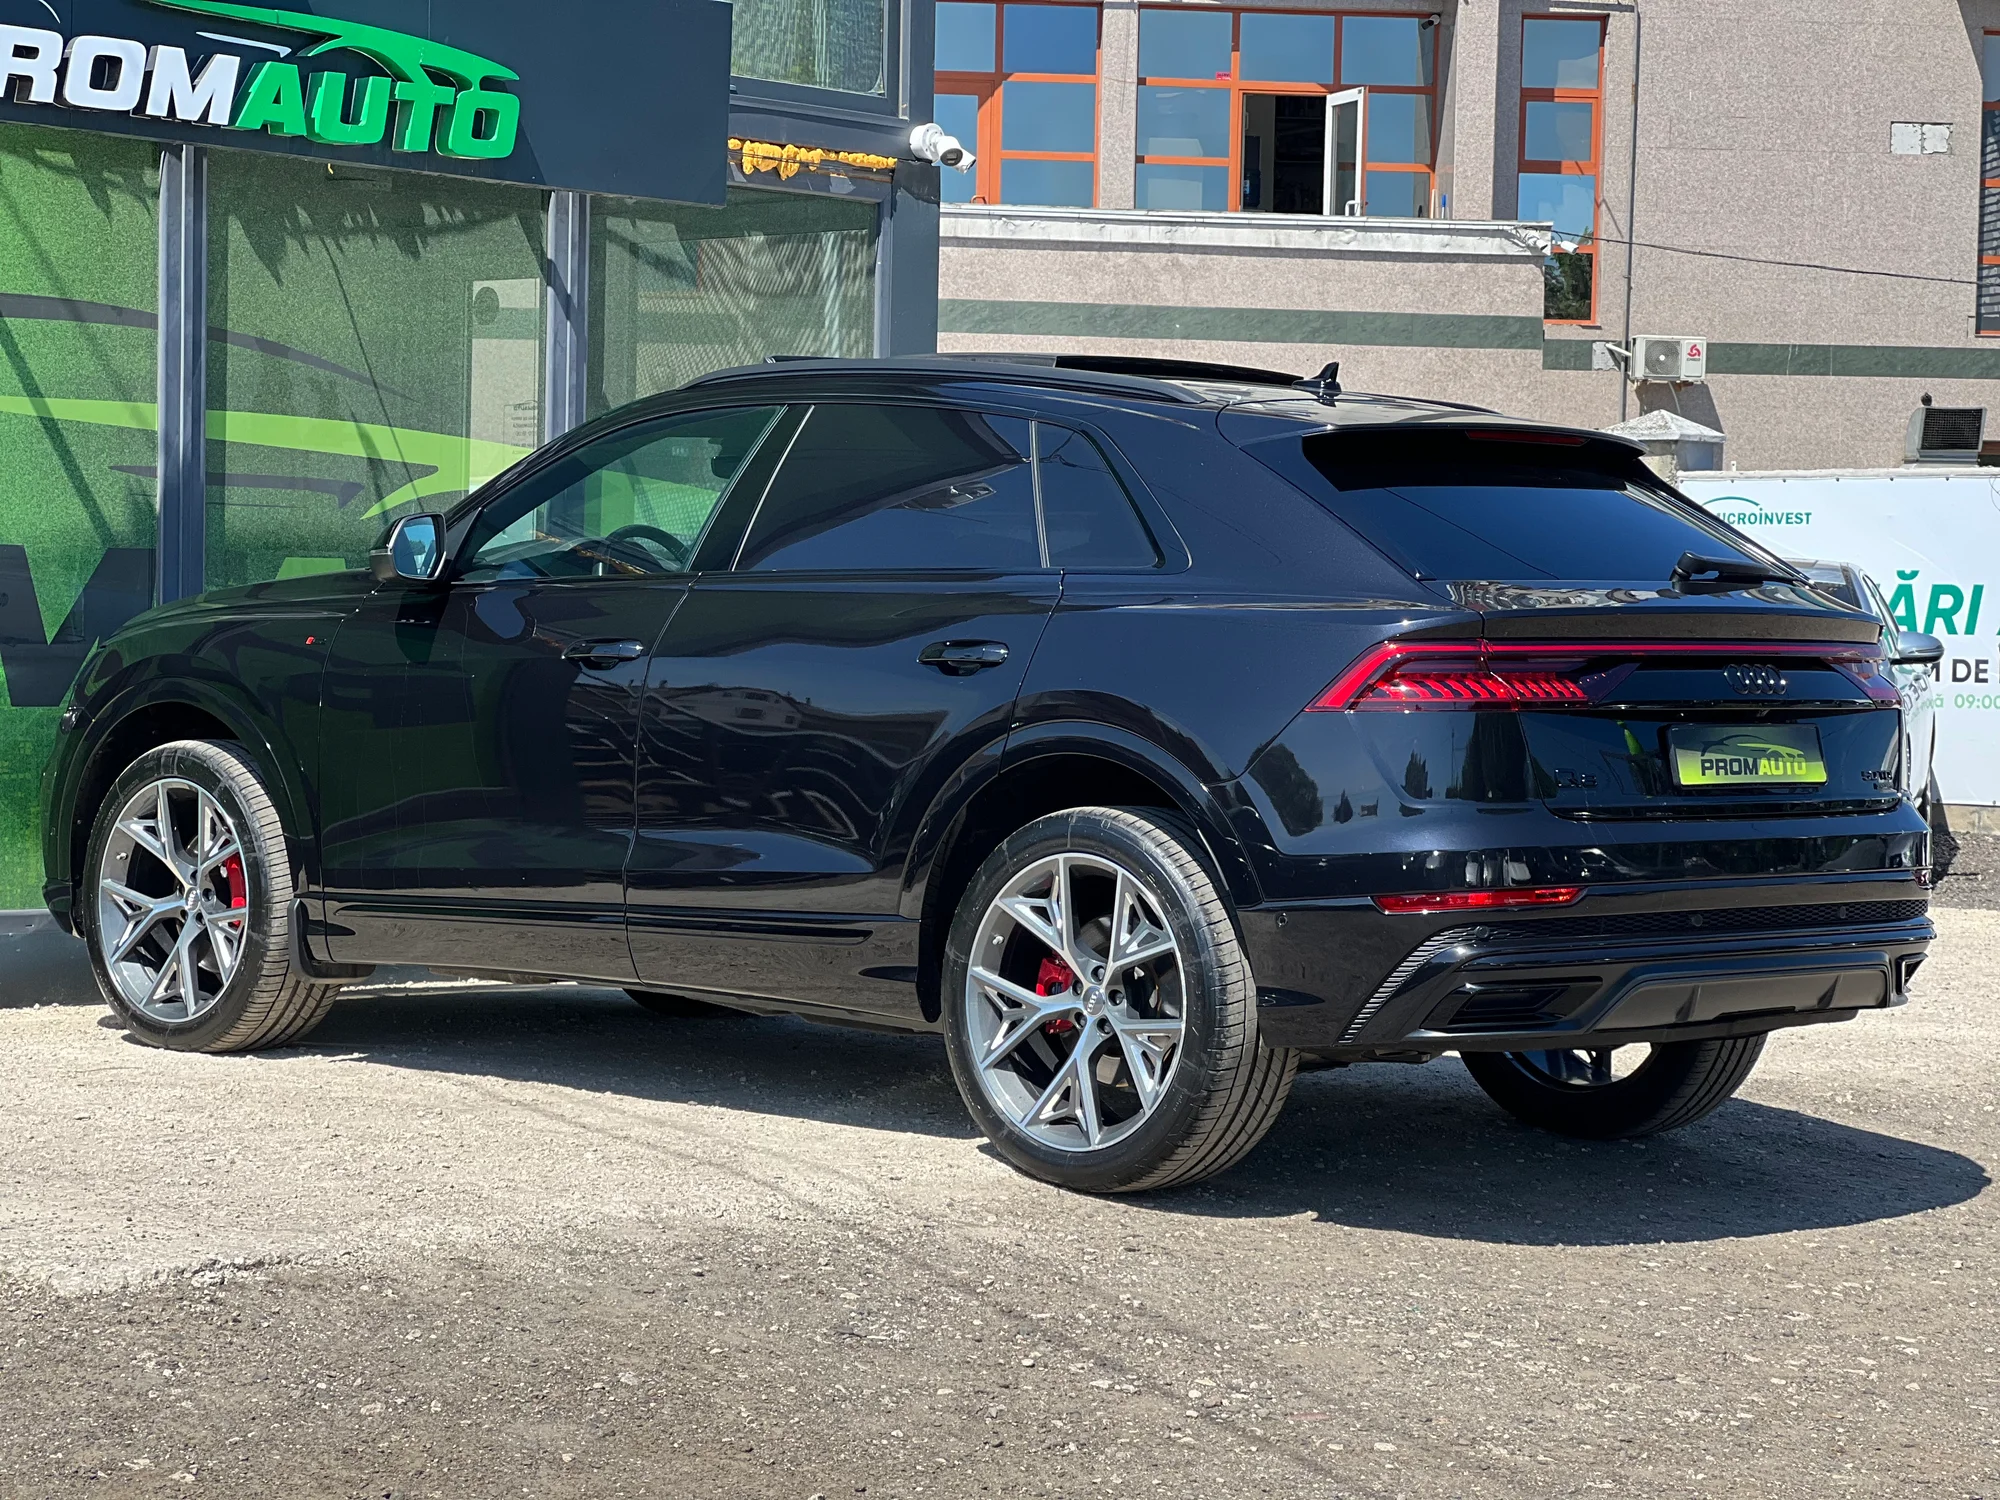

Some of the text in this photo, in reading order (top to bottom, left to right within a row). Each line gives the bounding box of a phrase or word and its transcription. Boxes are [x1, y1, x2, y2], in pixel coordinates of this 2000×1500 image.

[0, 24, 520, 158] ROMAUTO
[1886, 570, 1985, 636] ĂRI
[1952, 658, 1989, 683] DE
[1701, 757, 1807, 776] PROMAUTO
